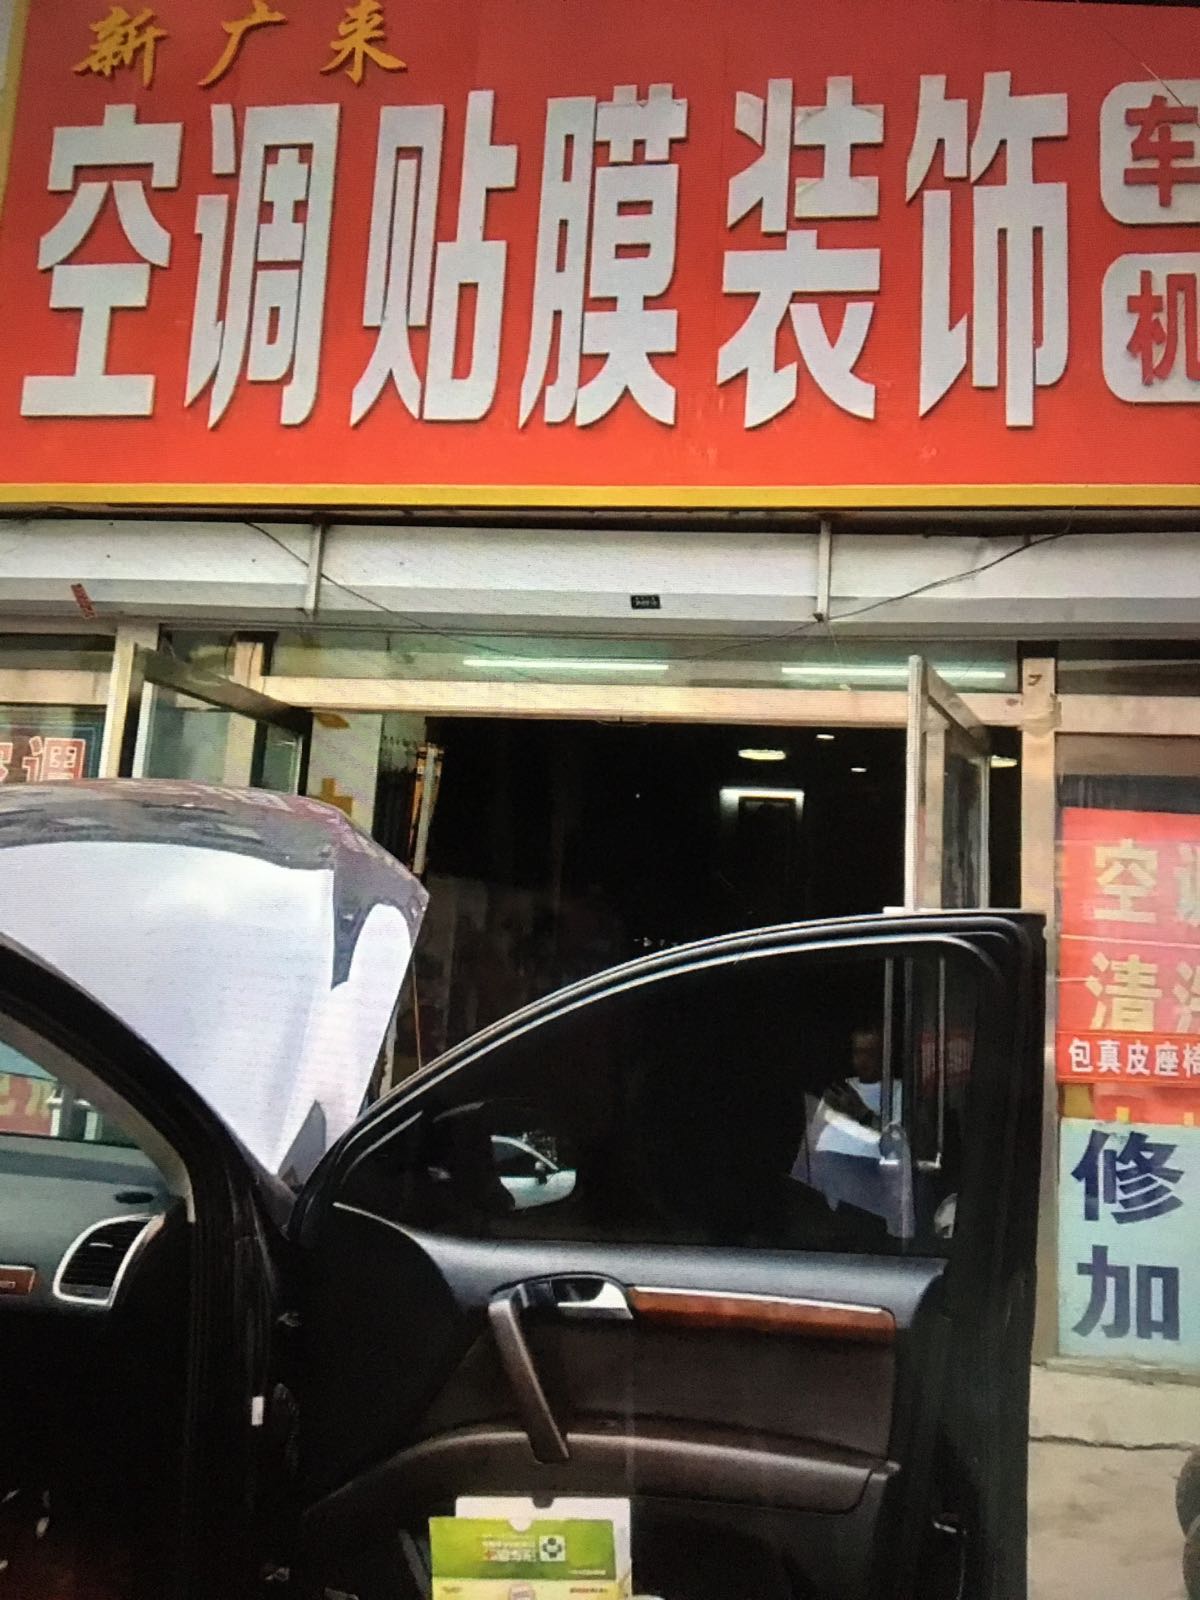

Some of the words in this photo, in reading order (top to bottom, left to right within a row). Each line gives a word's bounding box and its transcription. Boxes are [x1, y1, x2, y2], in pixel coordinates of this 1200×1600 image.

[72, 0, 407, 89] 新广来
[1123, 95, 1200, 208] 车
[20, 71, 1070, 430] 空调贴膜装饰
[1126, 269, 1200, 386] 机
[1071, 1128, 1185, 1225] 修
[1071, 1244, 1180, 1340] 加
